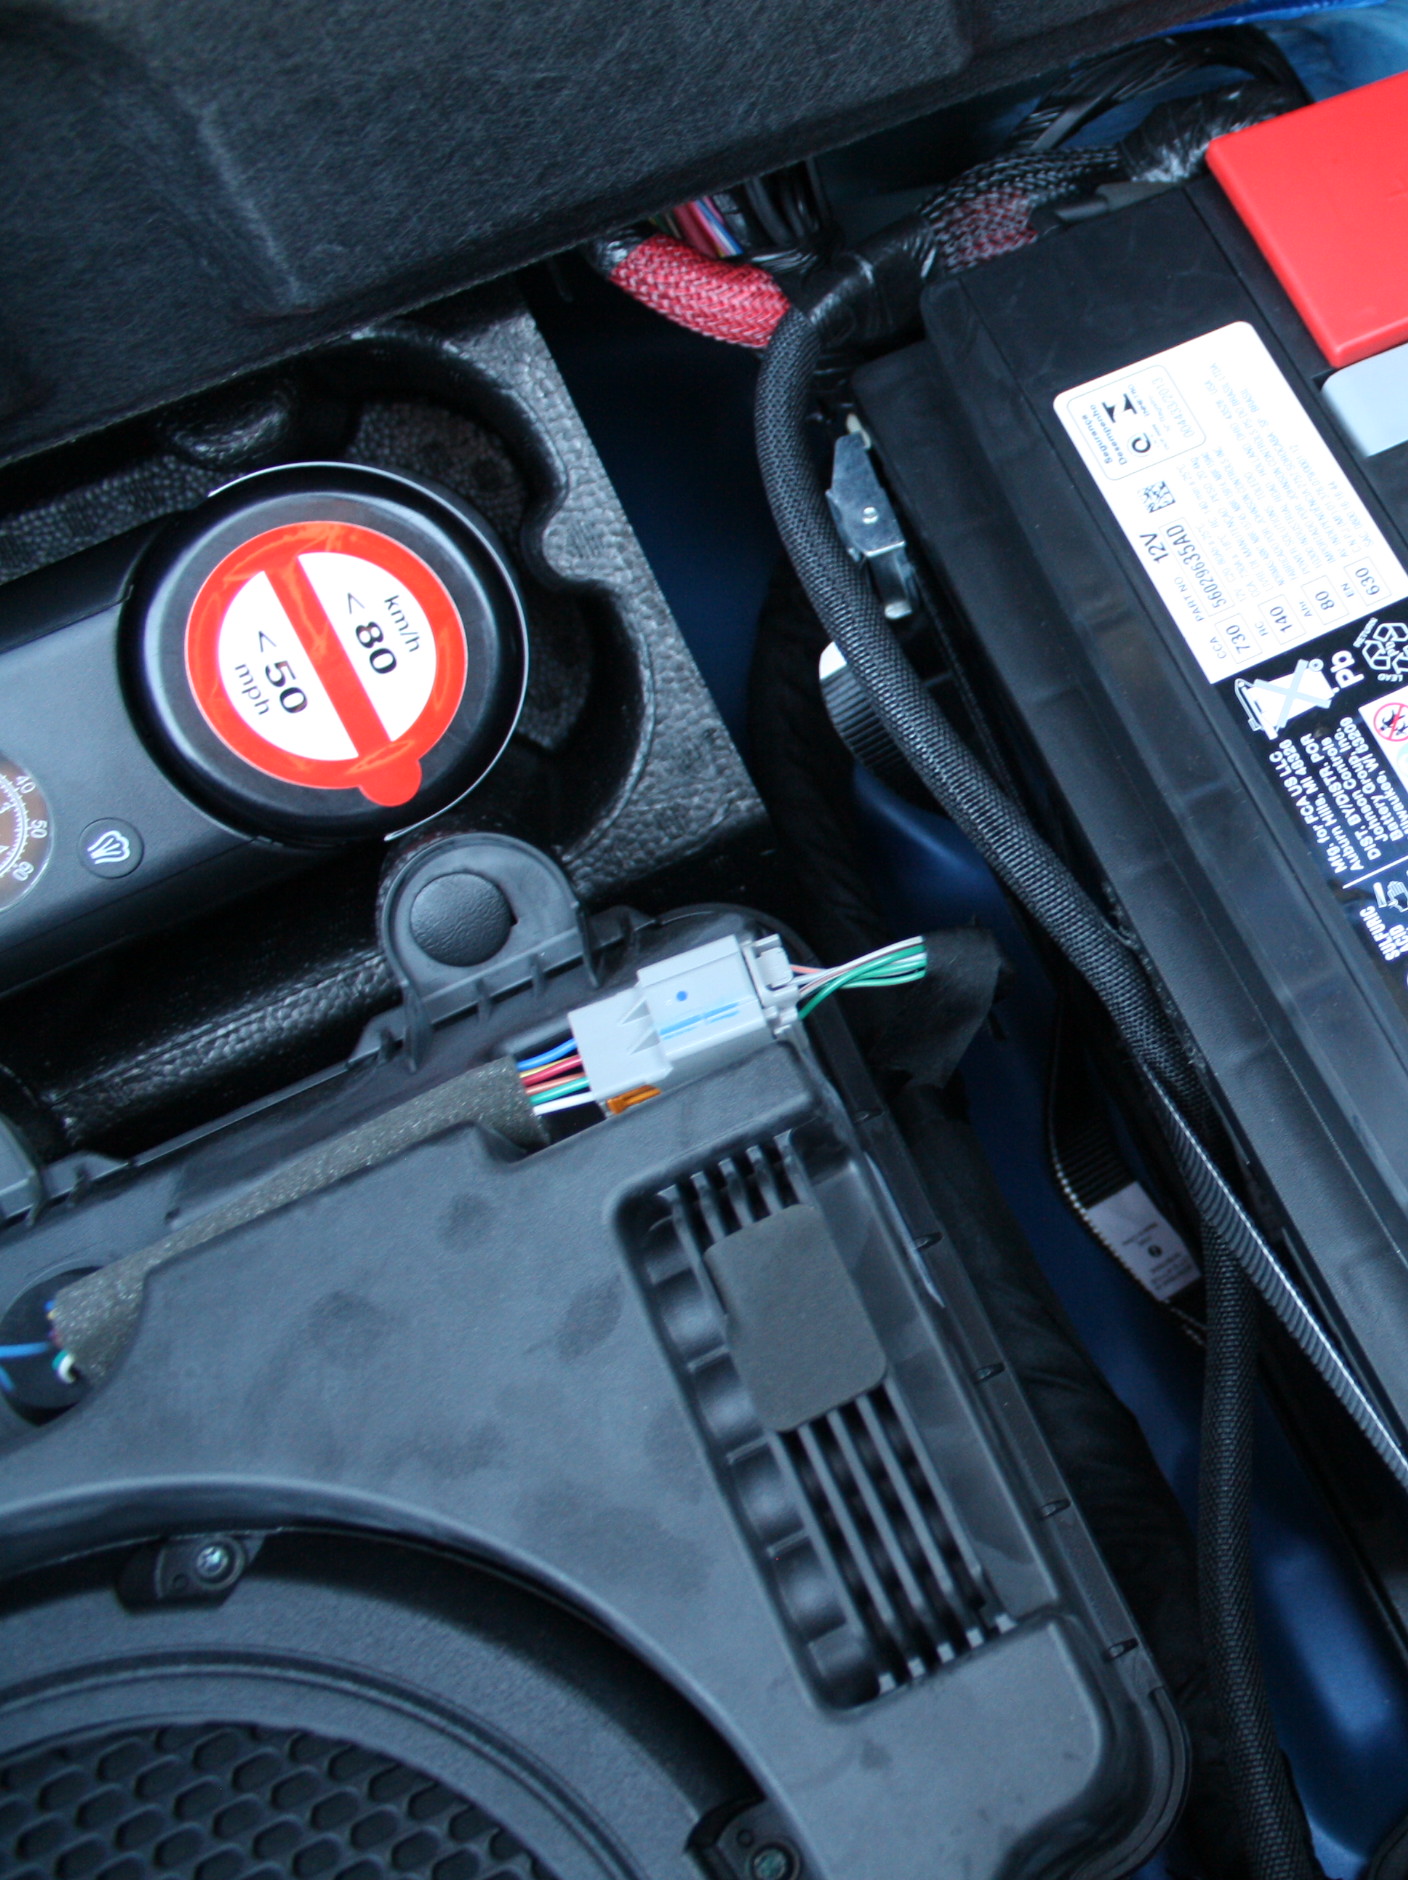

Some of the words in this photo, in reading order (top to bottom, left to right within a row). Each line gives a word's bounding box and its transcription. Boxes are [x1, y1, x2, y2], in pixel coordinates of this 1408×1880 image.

[1088, 403, 1129, 465] Desempenho
[1138, 531, 1170, 563] 12V
[1165, 523, 1227, 609] 56029635AD
[1354, 566, 1380, 595] 630
[1174, 576, 1187, 592] NO
[1341, 582, 1354, 597] EN
[1183, 595, 1205, 622] PART
[1314, 590, 1335, 610] 80
[384, 595, 420, 652] km/h
[1269, 605, 1293, 632] 140
[355, 621, 397, 675] 80
[1208, 636, 1227, 659] CCA
[1225, 624, 1251, 653] 730
[1326, 649, 1365, 688] Pb
[234, 664, 270, 715] mph
[265, 661, 308, 714] 50
[1299, 733, 1324, 763] POR
[1329, 728, 1352, 753] Inc.
[1268, 750, 1292, 777] LLC
[1319, 737, 1358, 790] Controls
[1345, 750, 1377, 794] Group,
[1359, 753, 1380, 772] WI
[16, 776, 36, 793] 40
[1283, 776, 1303, 797] US
[1299, 776, 1318, 794] MI
[1317, 762, 1362, 826] BY/DISTR.
[1294, 795, 1319, 824] FCA
[1312, 792, 1338, 826] Hills,
[1350, 789, 1389, 842] Johnson
[1369, 794, 1407, 841] Battery
[30, 819, 48, 839] 50
[1310, 824, 1330, 843] for
[1353, 825, 1382, 860] DIST.
[1323, 842, 1348, 873] Mfg.
[1329, 825, 1365, 872] Auburn
[1358, 905, 1402, 960] SULFURIC
